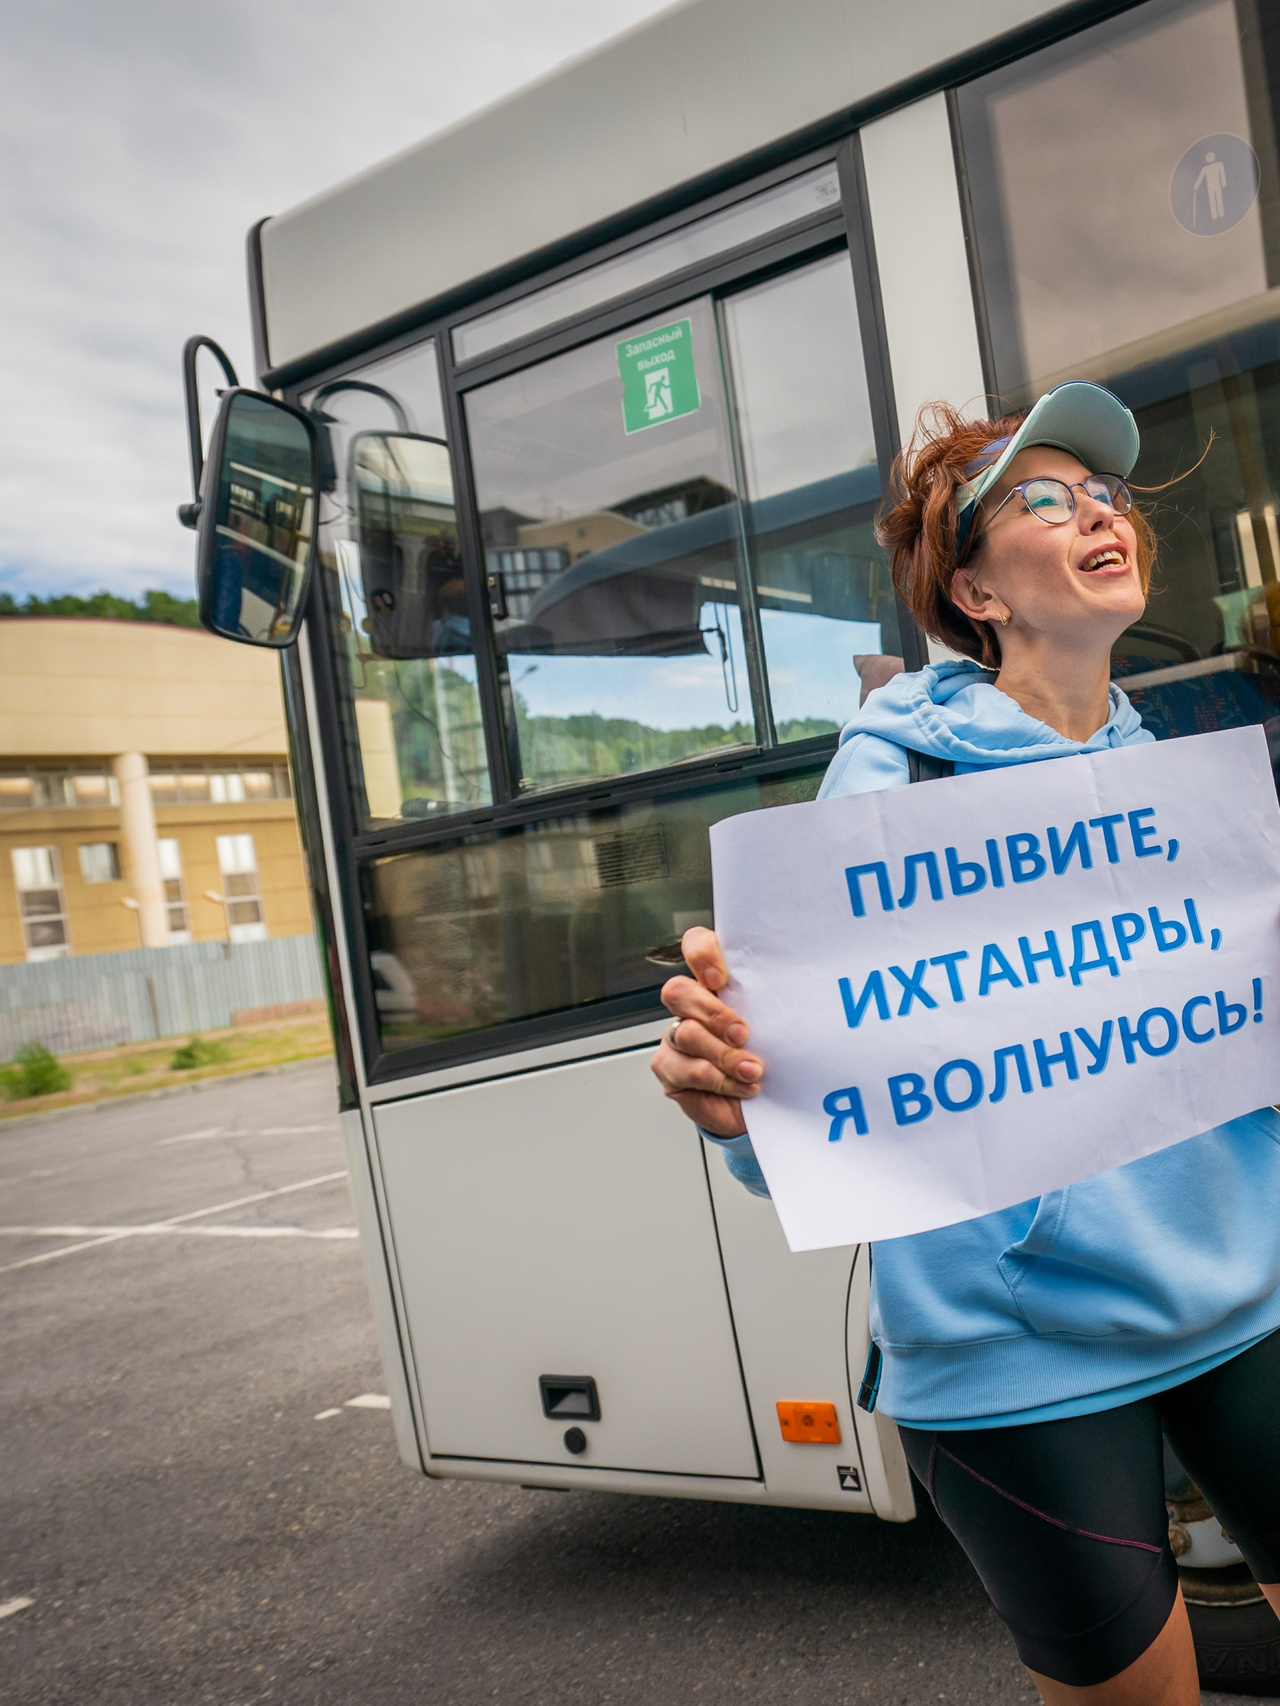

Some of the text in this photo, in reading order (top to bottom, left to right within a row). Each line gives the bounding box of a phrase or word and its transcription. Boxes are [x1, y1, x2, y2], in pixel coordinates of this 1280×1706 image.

[625, 326, 683, 357] Запасный
[637, 349, 675, 371] выход
[844, 807, 1179, 917] ПЛЫВИТЕ,
[837, 898, 1222, 1028] ИХТАНДРЫ,
[822, 977, 1264, 1143] Я ВОЛНУЮСЬ!
